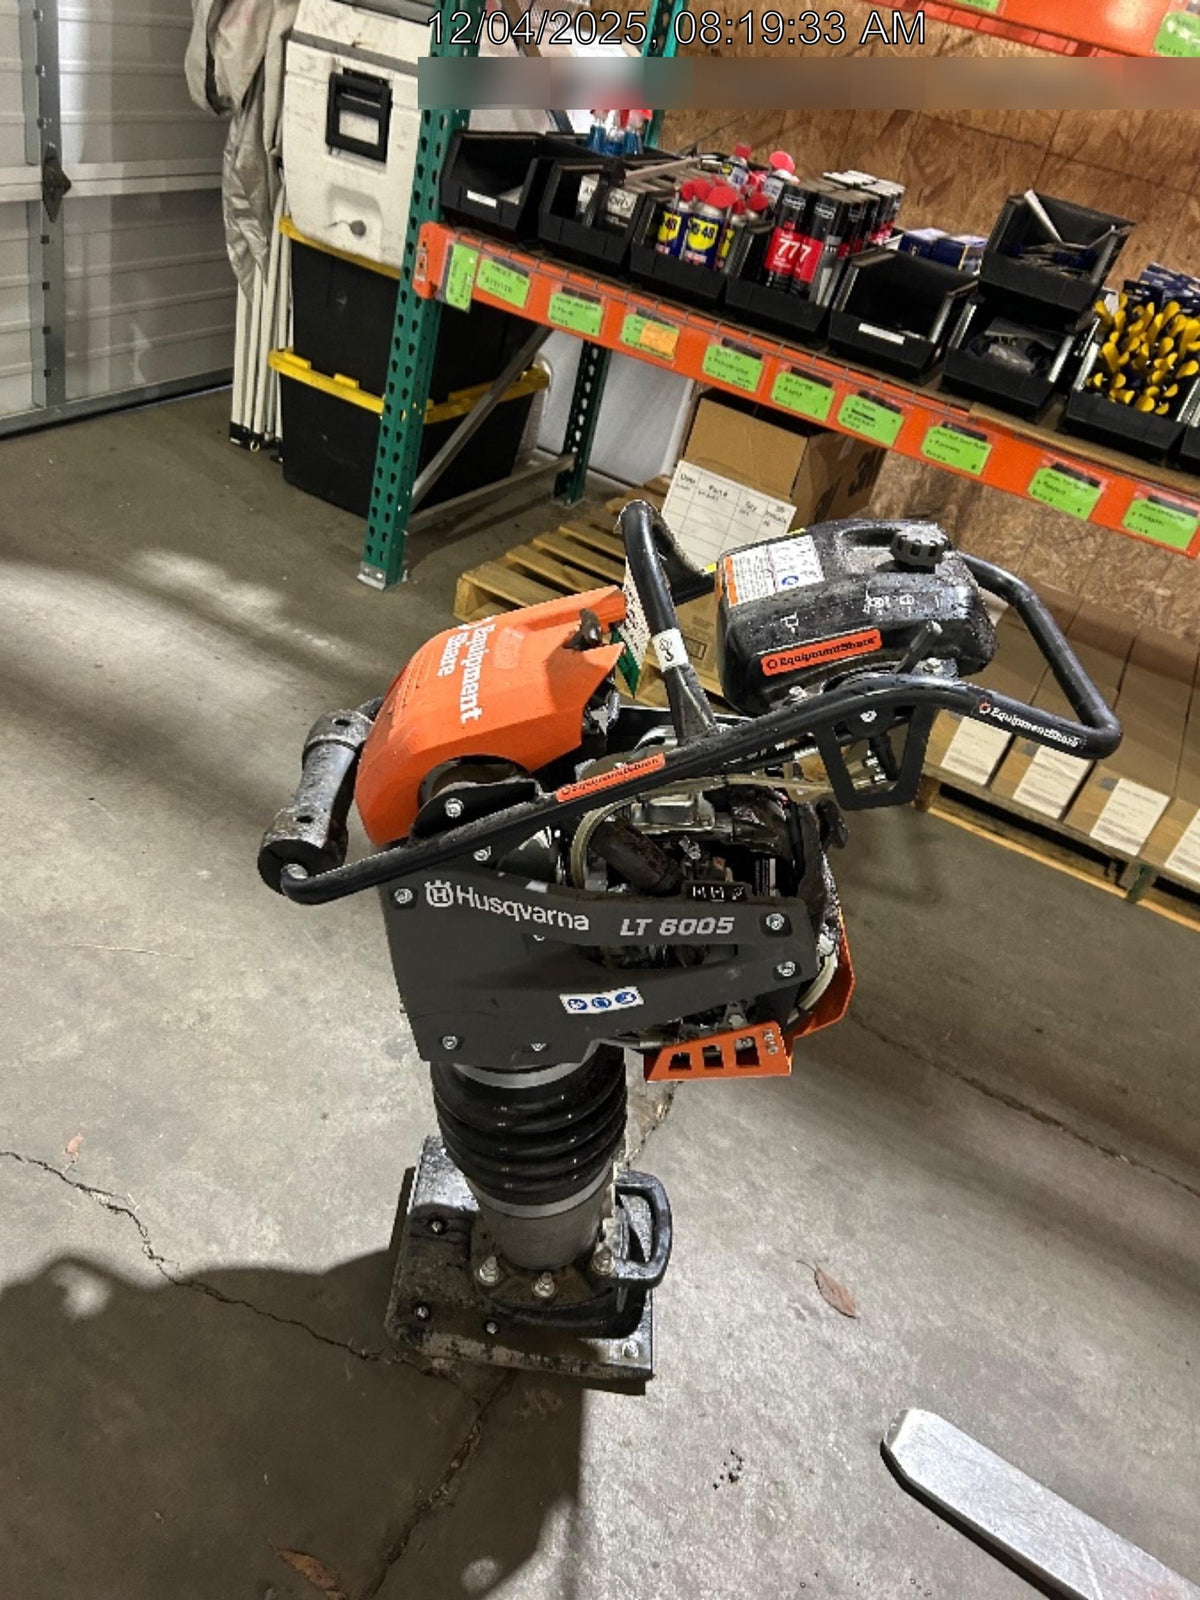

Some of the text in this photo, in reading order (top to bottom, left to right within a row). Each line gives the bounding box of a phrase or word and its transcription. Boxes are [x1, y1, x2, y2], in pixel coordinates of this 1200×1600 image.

[437, 630, 470, 678] Share
[460, 623, 497, 725] Equipment
[457, 885, 590, 931] Husqvarna
[620, 916, 734, 937] LT 6005
